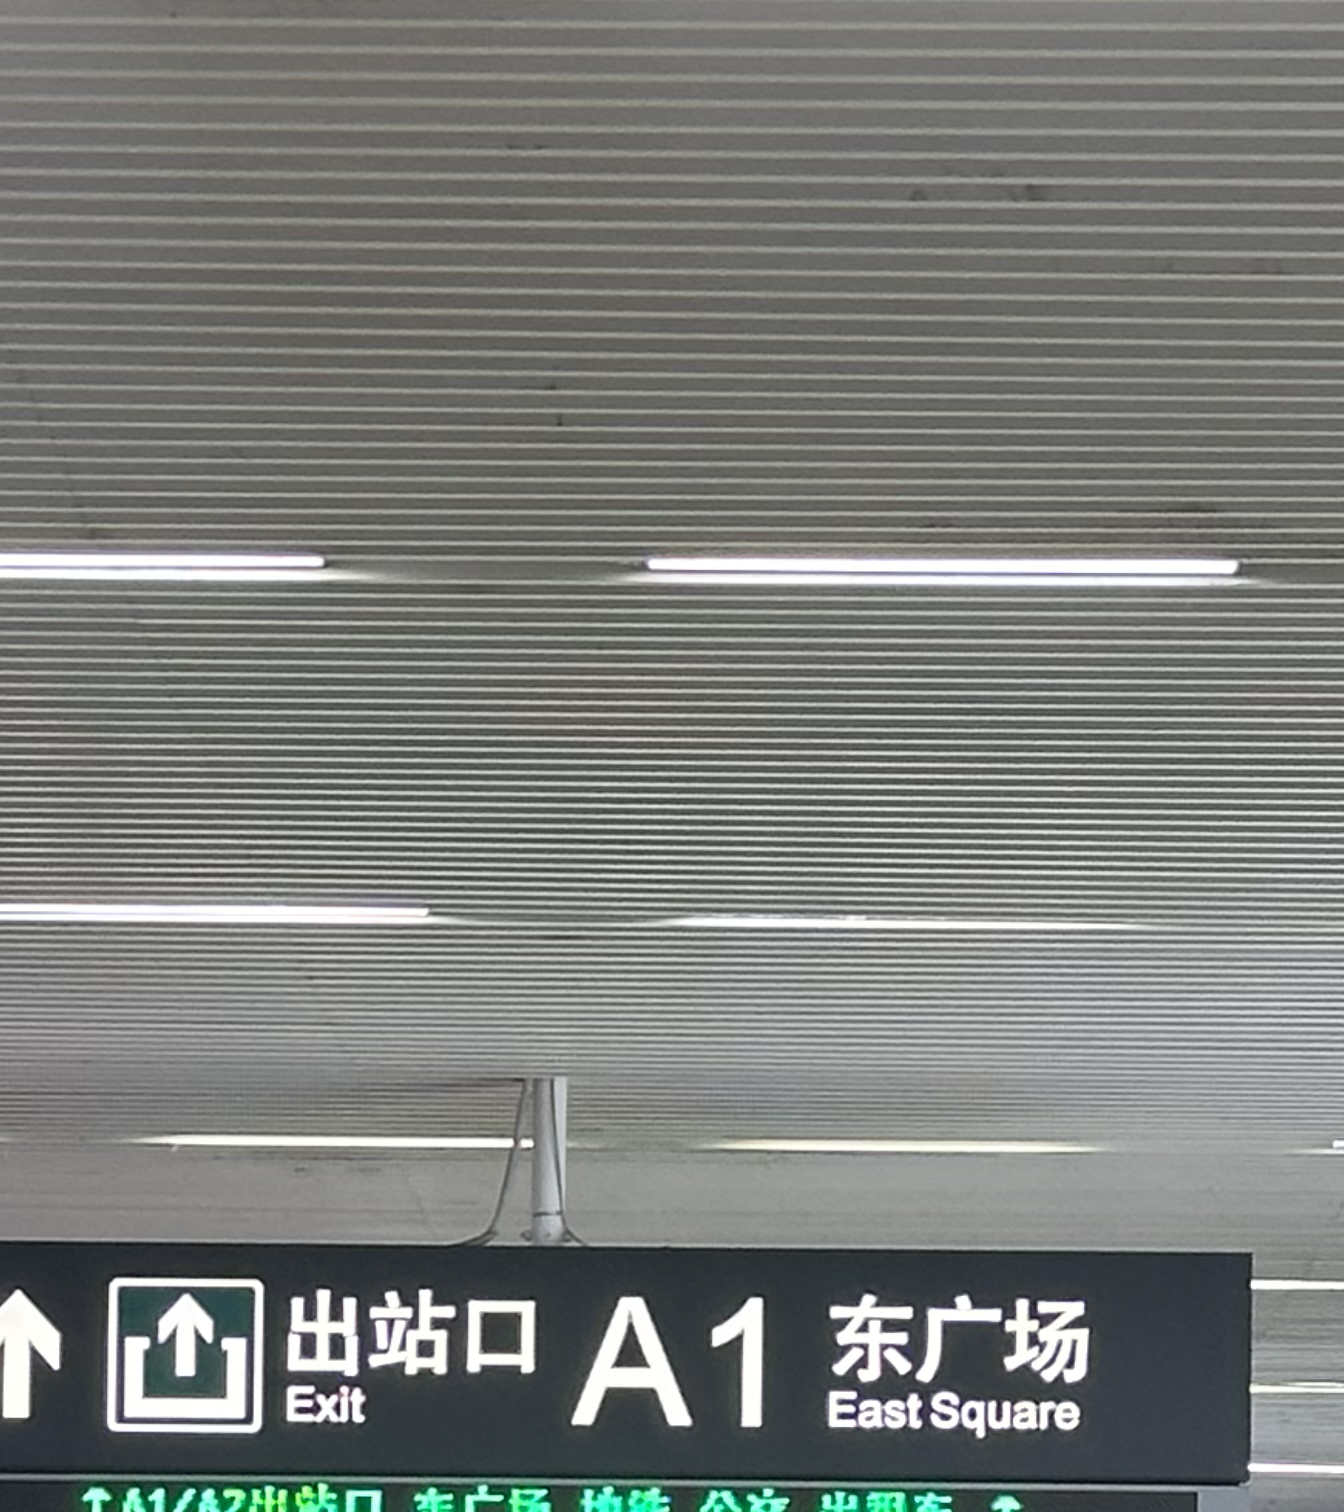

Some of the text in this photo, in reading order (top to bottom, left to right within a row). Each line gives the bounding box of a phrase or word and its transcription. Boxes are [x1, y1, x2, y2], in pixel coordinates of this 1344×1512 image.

[286, 1288, 1090, 1428] 出站口 A1 东广场
[285, 1384, 366, 1424] Exit
[827, 1391, 1081, 1439] East Square
